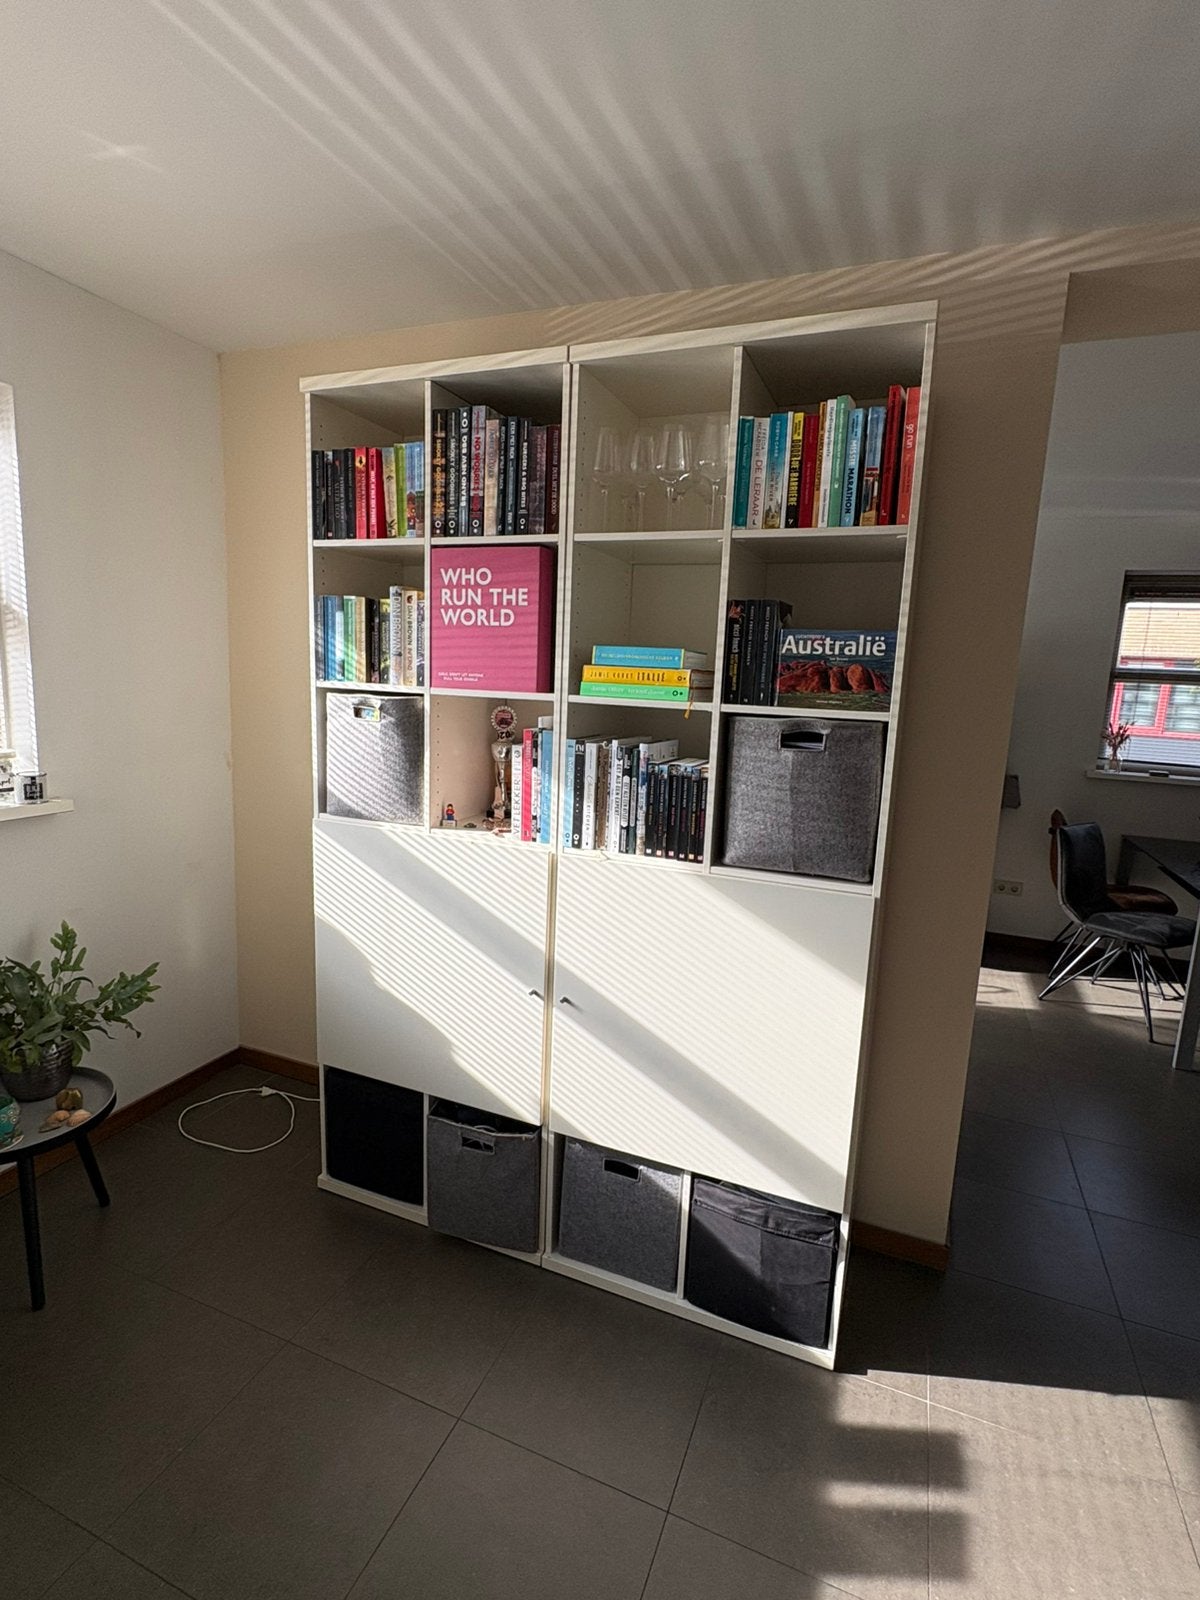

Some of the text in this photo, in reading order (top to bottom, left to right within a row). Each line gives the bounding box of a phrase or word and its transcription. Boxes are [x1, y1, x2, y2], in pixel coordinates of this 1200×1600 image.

[906, 424, 914, 434] go
[474, 436, 481, 450] NO
[793, 439, 802, 459] DOOR
[848, 440, 858, 466] MISSIE
[473, 453, 481, 490] WORRIES
[791, 460, 800, 469] JE
[752, 460, 763, 516] DE LERAAR
[788, 472, 799, 506] BARRIÈRE
[844, 468, 854, 514] MARATHON
[440, 568, 492, 586] WHO
[441, 588, 528, 606] RUN THE
[392, 596, 402, 652] DAN BROWN
[440, 608, 515, 626] WORLD
[782, 634, 886, 656] Australië
[636, 672, 666, 682] ITALIË
